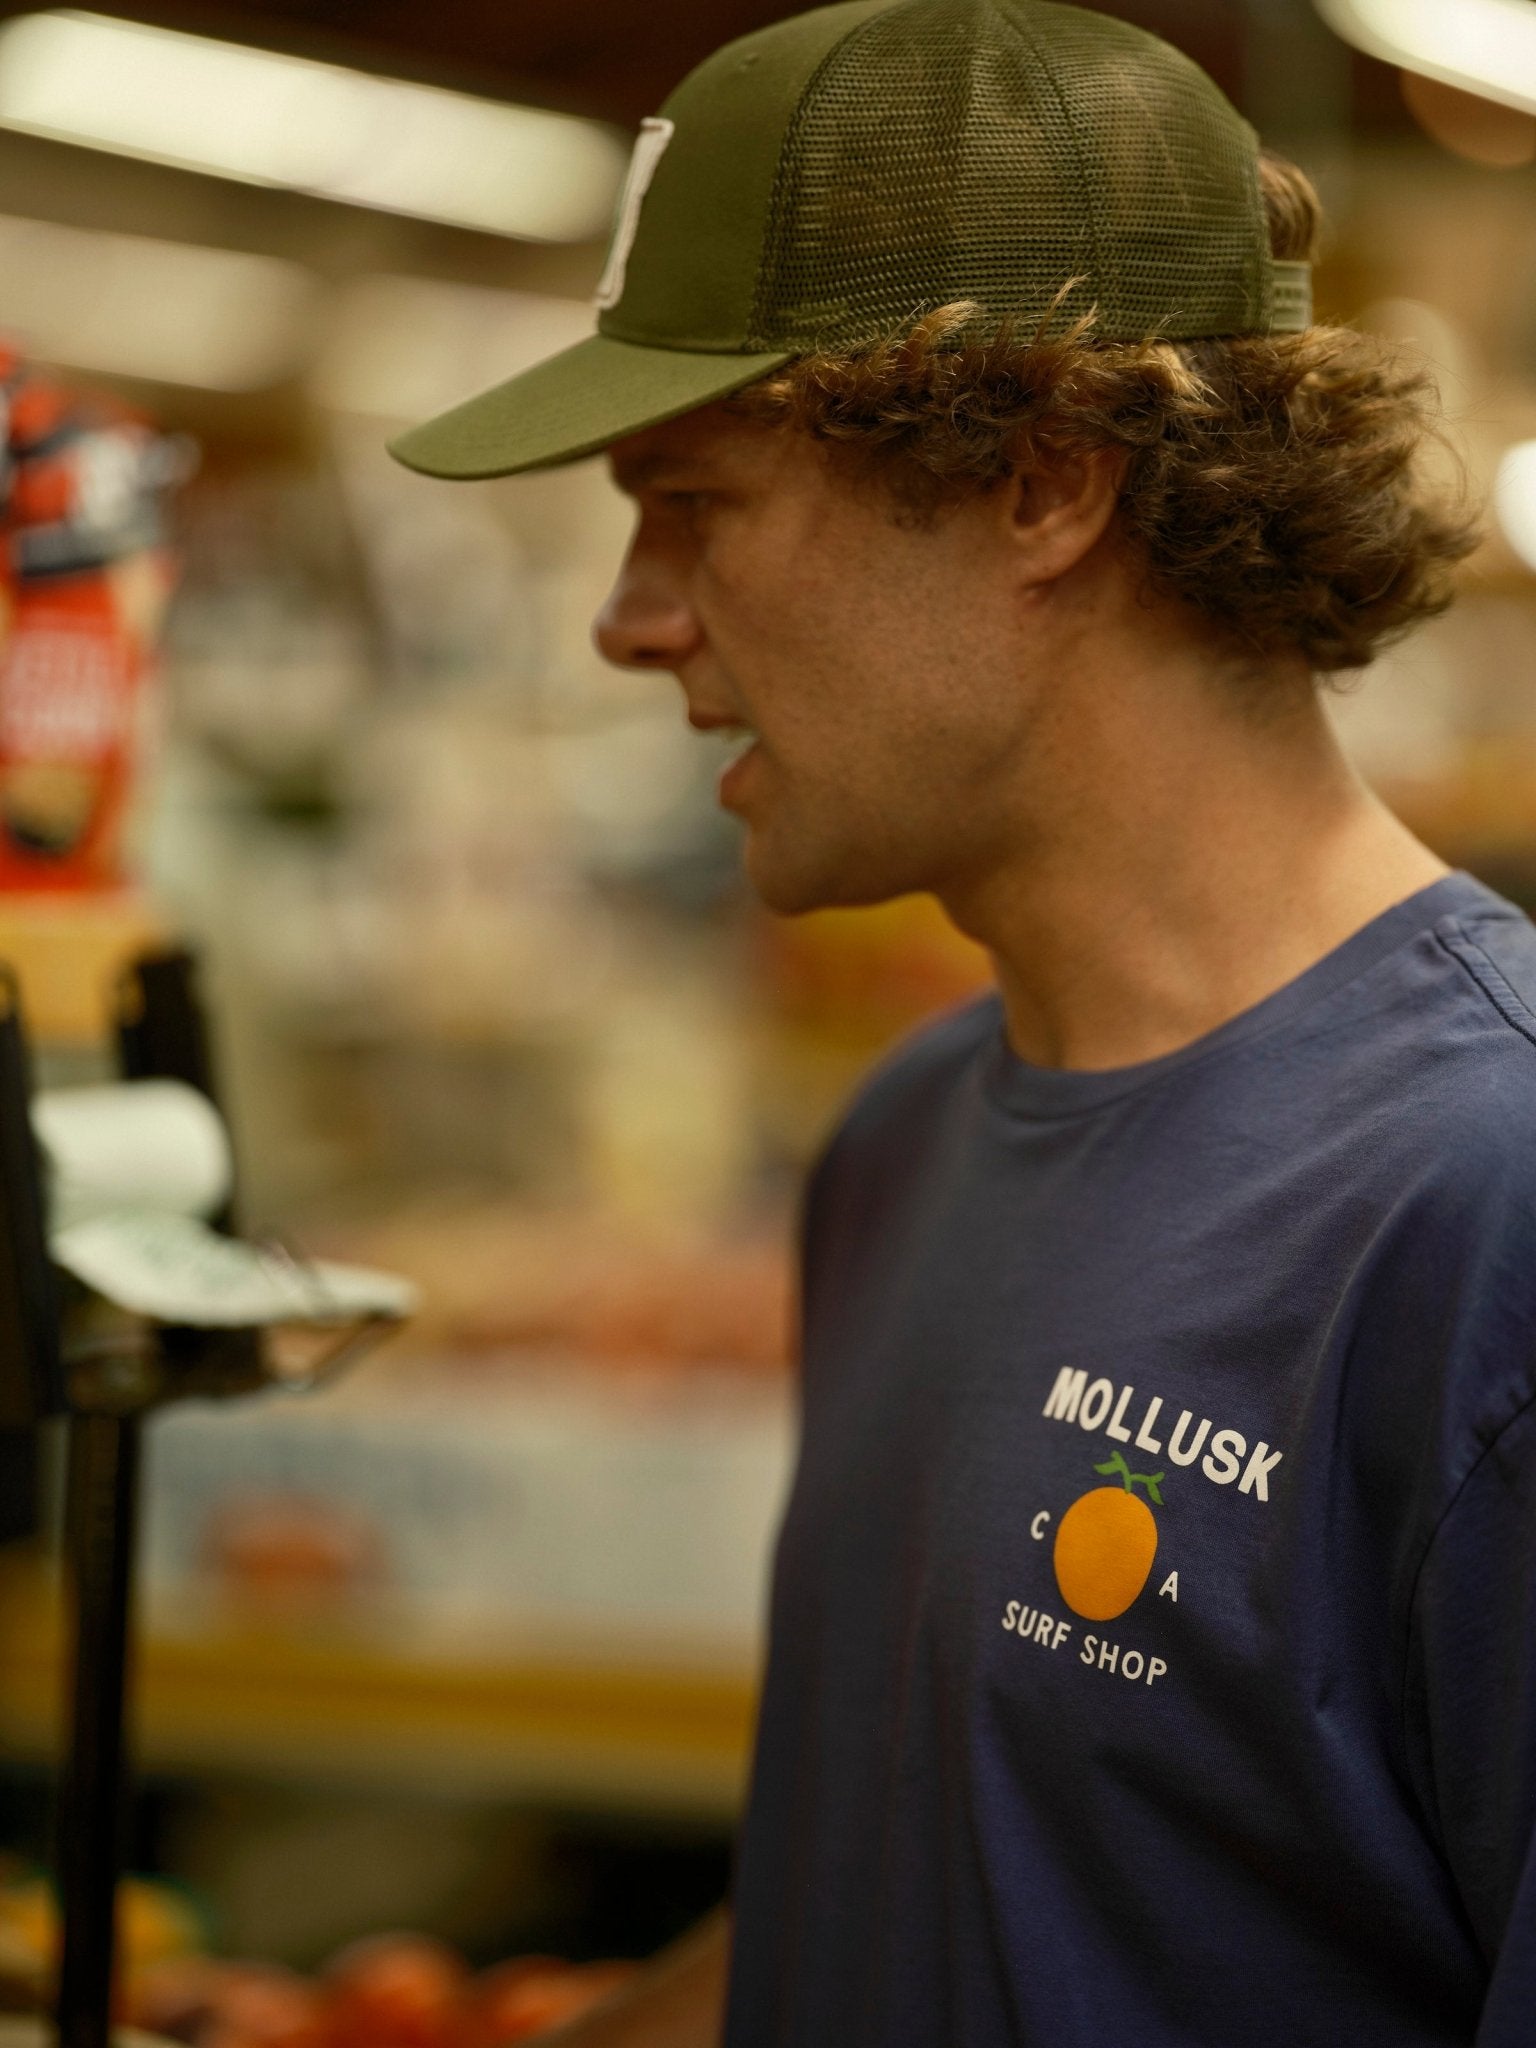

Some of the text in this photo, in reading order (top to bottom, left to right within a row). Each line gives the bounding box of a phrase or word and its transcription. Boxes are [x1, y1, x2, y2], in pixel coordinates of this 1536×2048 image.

[1042, 1365, 1283, 1502] MOLLUSK
[1030, 1510, 1179, 1603] C A
[1001, 1599, 1168, 1686] SURF SHOP
